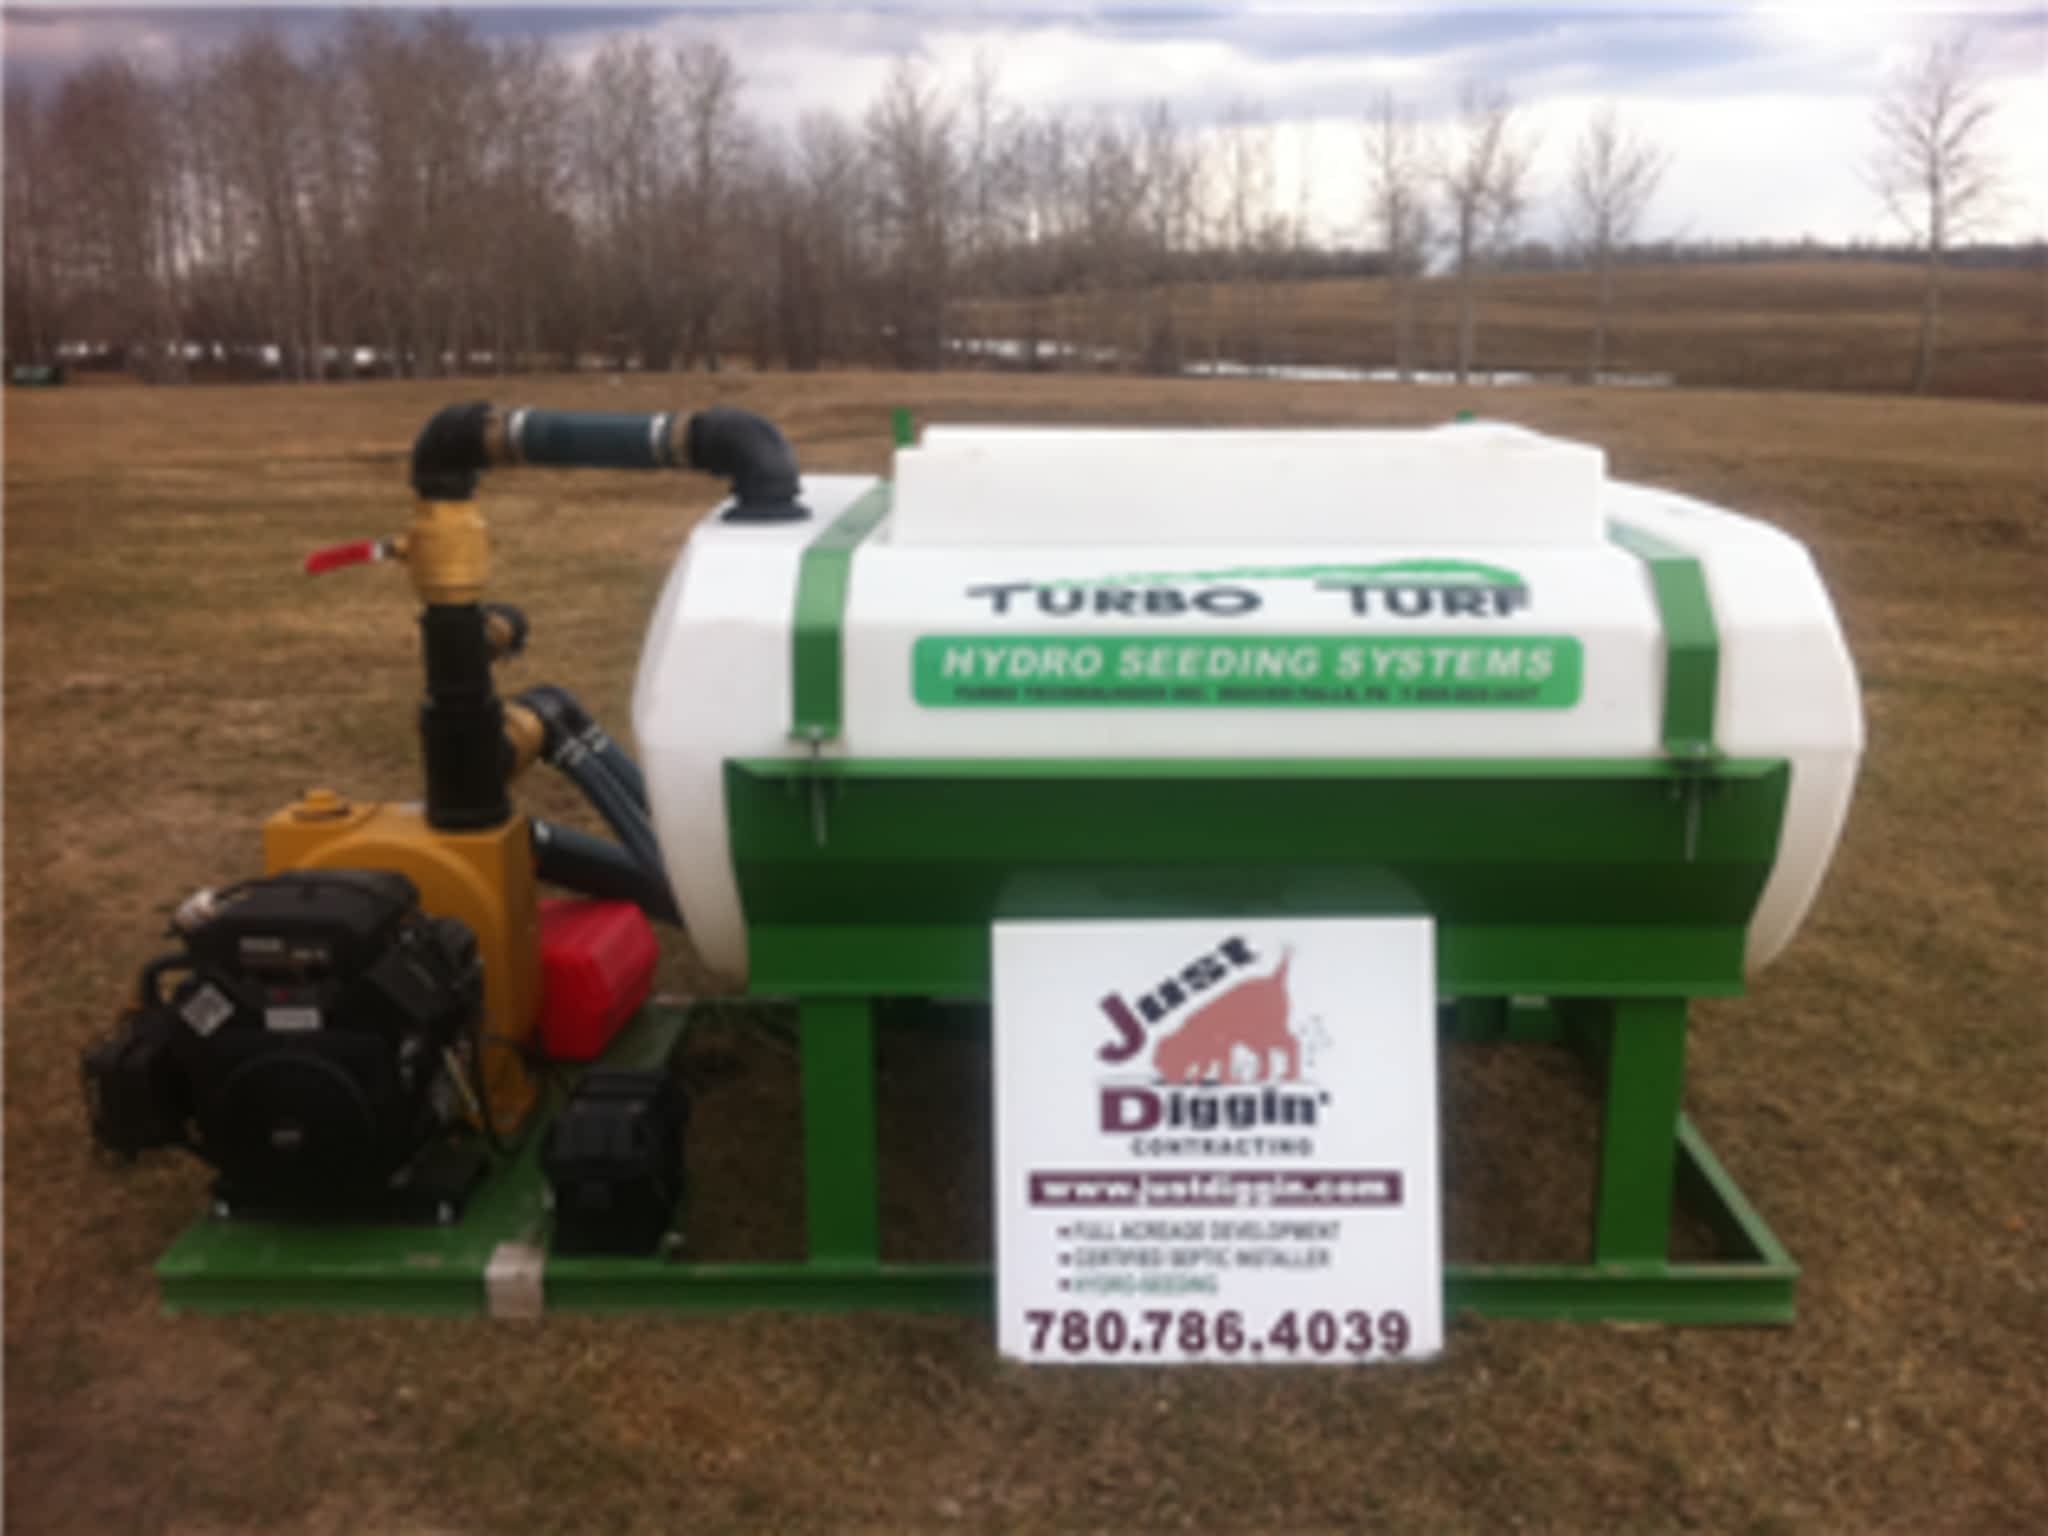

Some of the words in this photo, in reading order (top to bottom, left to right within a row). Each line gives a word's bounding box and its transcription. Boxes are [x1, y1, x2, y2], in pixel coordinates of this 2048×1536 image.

[965, 582, 1263, 617] TURBO
[1315, 581, 1530, 617] TURF
[941, 645, 1103, 679] HYDRO
[1118, 645, 1321, 679] SEEDING
[1336, 645, 1554, 679] SYSTEMS
[1097, 935, 1257, 1064] Just
[1131, 1138, 1315, 1157] CONTRACTING
[1025, 1309, 1411, 1355] 780.786.4039
